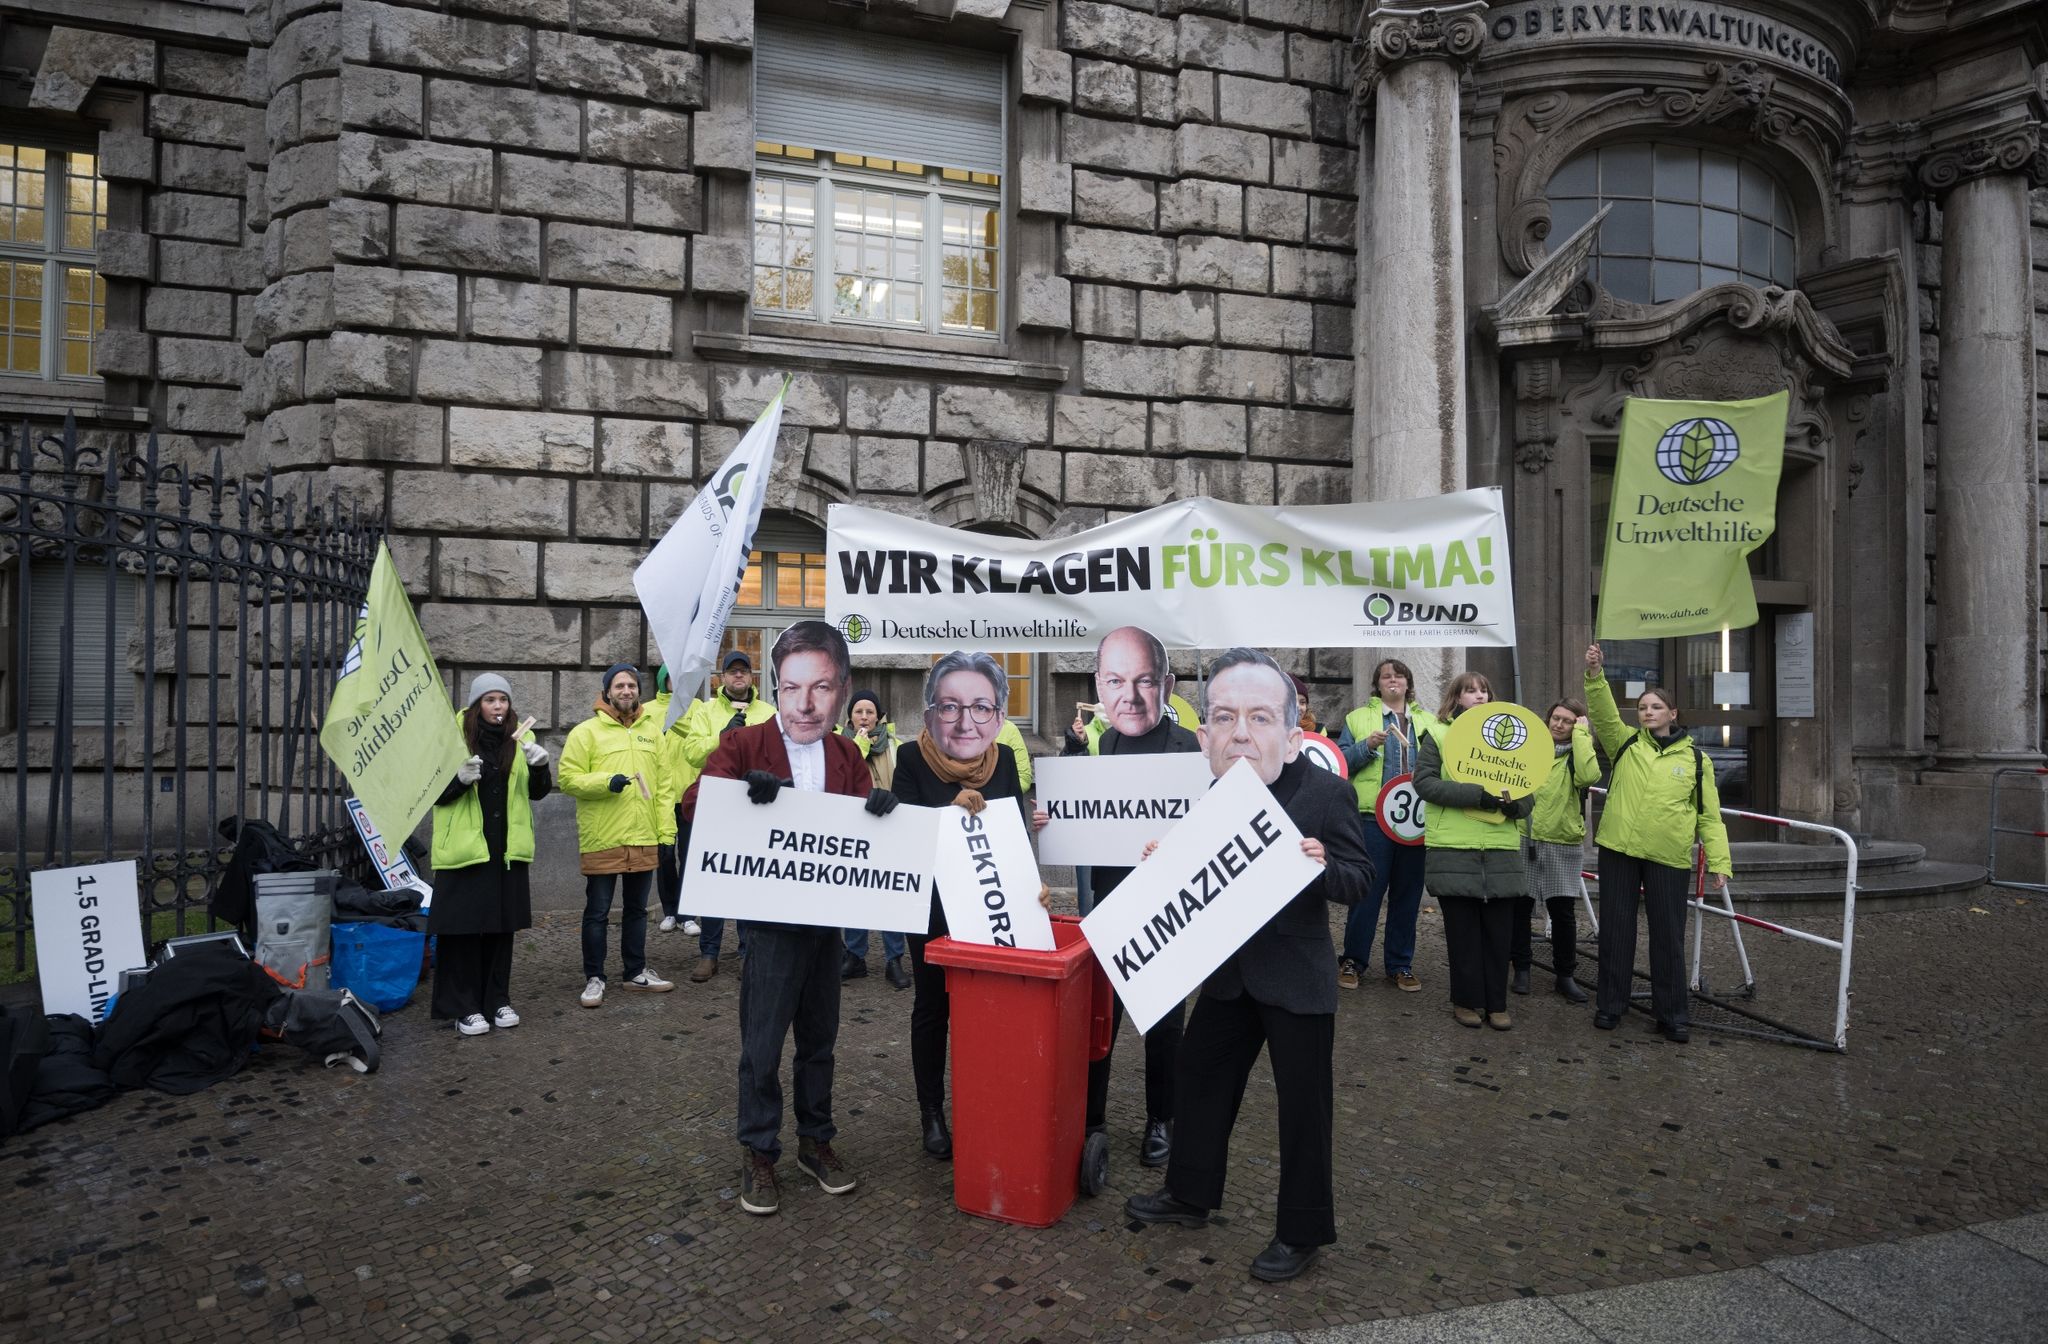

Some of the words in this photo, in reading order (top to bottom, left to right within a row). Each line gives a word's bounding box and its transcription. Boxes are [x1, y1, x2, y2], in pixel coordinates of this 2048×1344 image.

[1636, 491, 1744, 516] Deutsche
[1615, 520, 1763, 544] Umwelthilfe
[838, 550, 942, 595] WIR
[952, 546, 1151, 595] KLAGEN
[1161, 527, 1290, 590] FÜRS
[1301, 536, 1496, 590] KLIMA!
[1398, 602, 1478, 622] BUND
[1640, 606, 1709, 621] www.duh.de
[881, 618, 968, 639] Deutsche
[971, 618, 1088, 639] Umwelthilfe
[1363, 628, 1391, 637] FRIENDS
[1405, 628, 1416, 637] THE
[1420, 628, 1441, 637] EARTH
[1444, 628, 1479, 637] GERMANY
[1469, 746, 1527, 772] Deutsche
[1456, 760, 1532, 790] Umwelthilfe
[768, 828, 870, 860] PARISER
[701, 850, 922, 893] KLIMAABKOMMEN
[74, 875, 98, 909] 1,5
[1112, 808, 1282, 982] KLIMAZIELE
[80, 915, 111, 1027] GRAD-LIM
